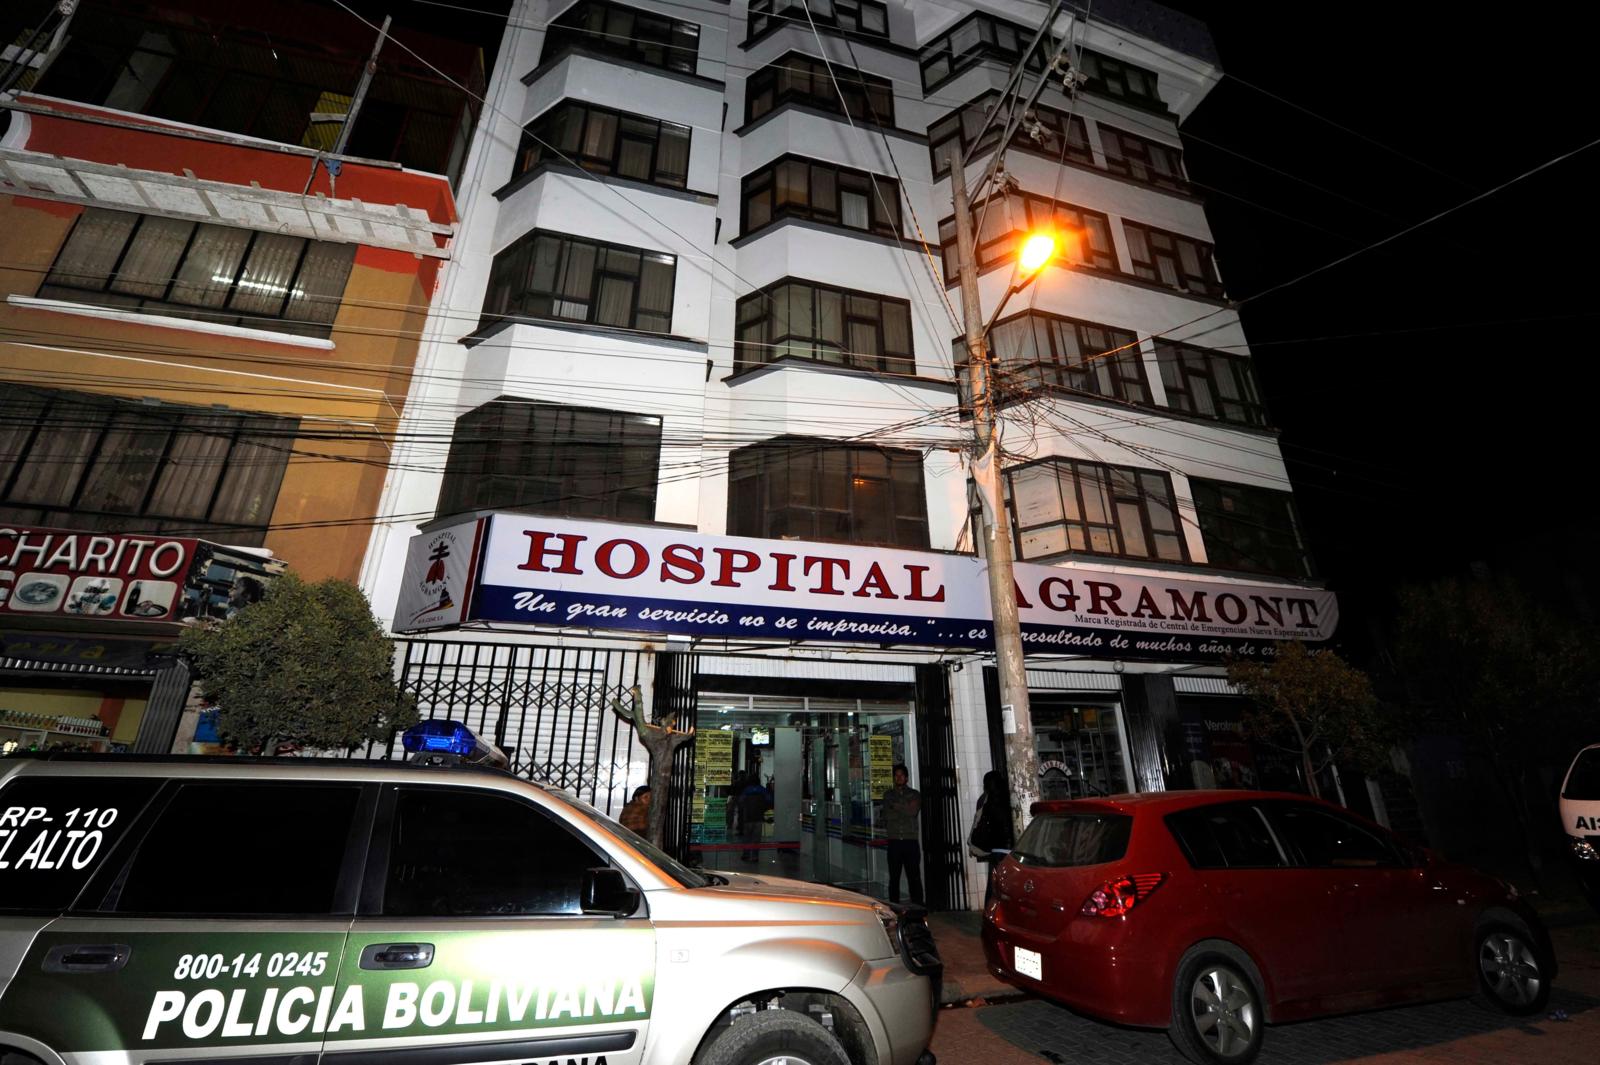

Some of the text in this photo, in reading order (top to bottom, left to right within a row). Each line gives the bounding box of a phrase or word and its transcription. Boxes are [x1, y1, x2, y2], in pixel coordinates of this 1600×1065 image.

[427, 531, 457, 549] HOSPITAL
[517, 530, 946, 603] HOSPITAL
[513, 591, 557, 612] Un
[566, 602, 627, 621] gran
[638, 607, 729, 625] servicio
[739, 612, 765, 627] no
[774, 617, 799, 630] se
[807, 616, 918, 637] improvisa.
[1021, 629, 1103, 647] resultado
[1109, 634, 1130, 649] de
[1136, 636, 1192, 652] muchos
[1199, 639, 1232, 654] años
[1239, 642, 1257, 656] de
[1074, 614, 1102, 625] Marca
[1104, 617, 1147, 629] Registrada
[1148, 619, 1158, 629] de
[1159, 621, 1188, 632] Central
[1190, 623, 1200, 632] de
[1201, 623, 1248, 635] Emergencias
[1249, 626, 1272, 635] Nueva
[65, 807, 119, 829] 110
[14, 828, 103, 870] ALTO
[173, 951, 329, 981] 800-14 0245
[142, 976, 647, 1040] POLICIA BOLIVIANA
